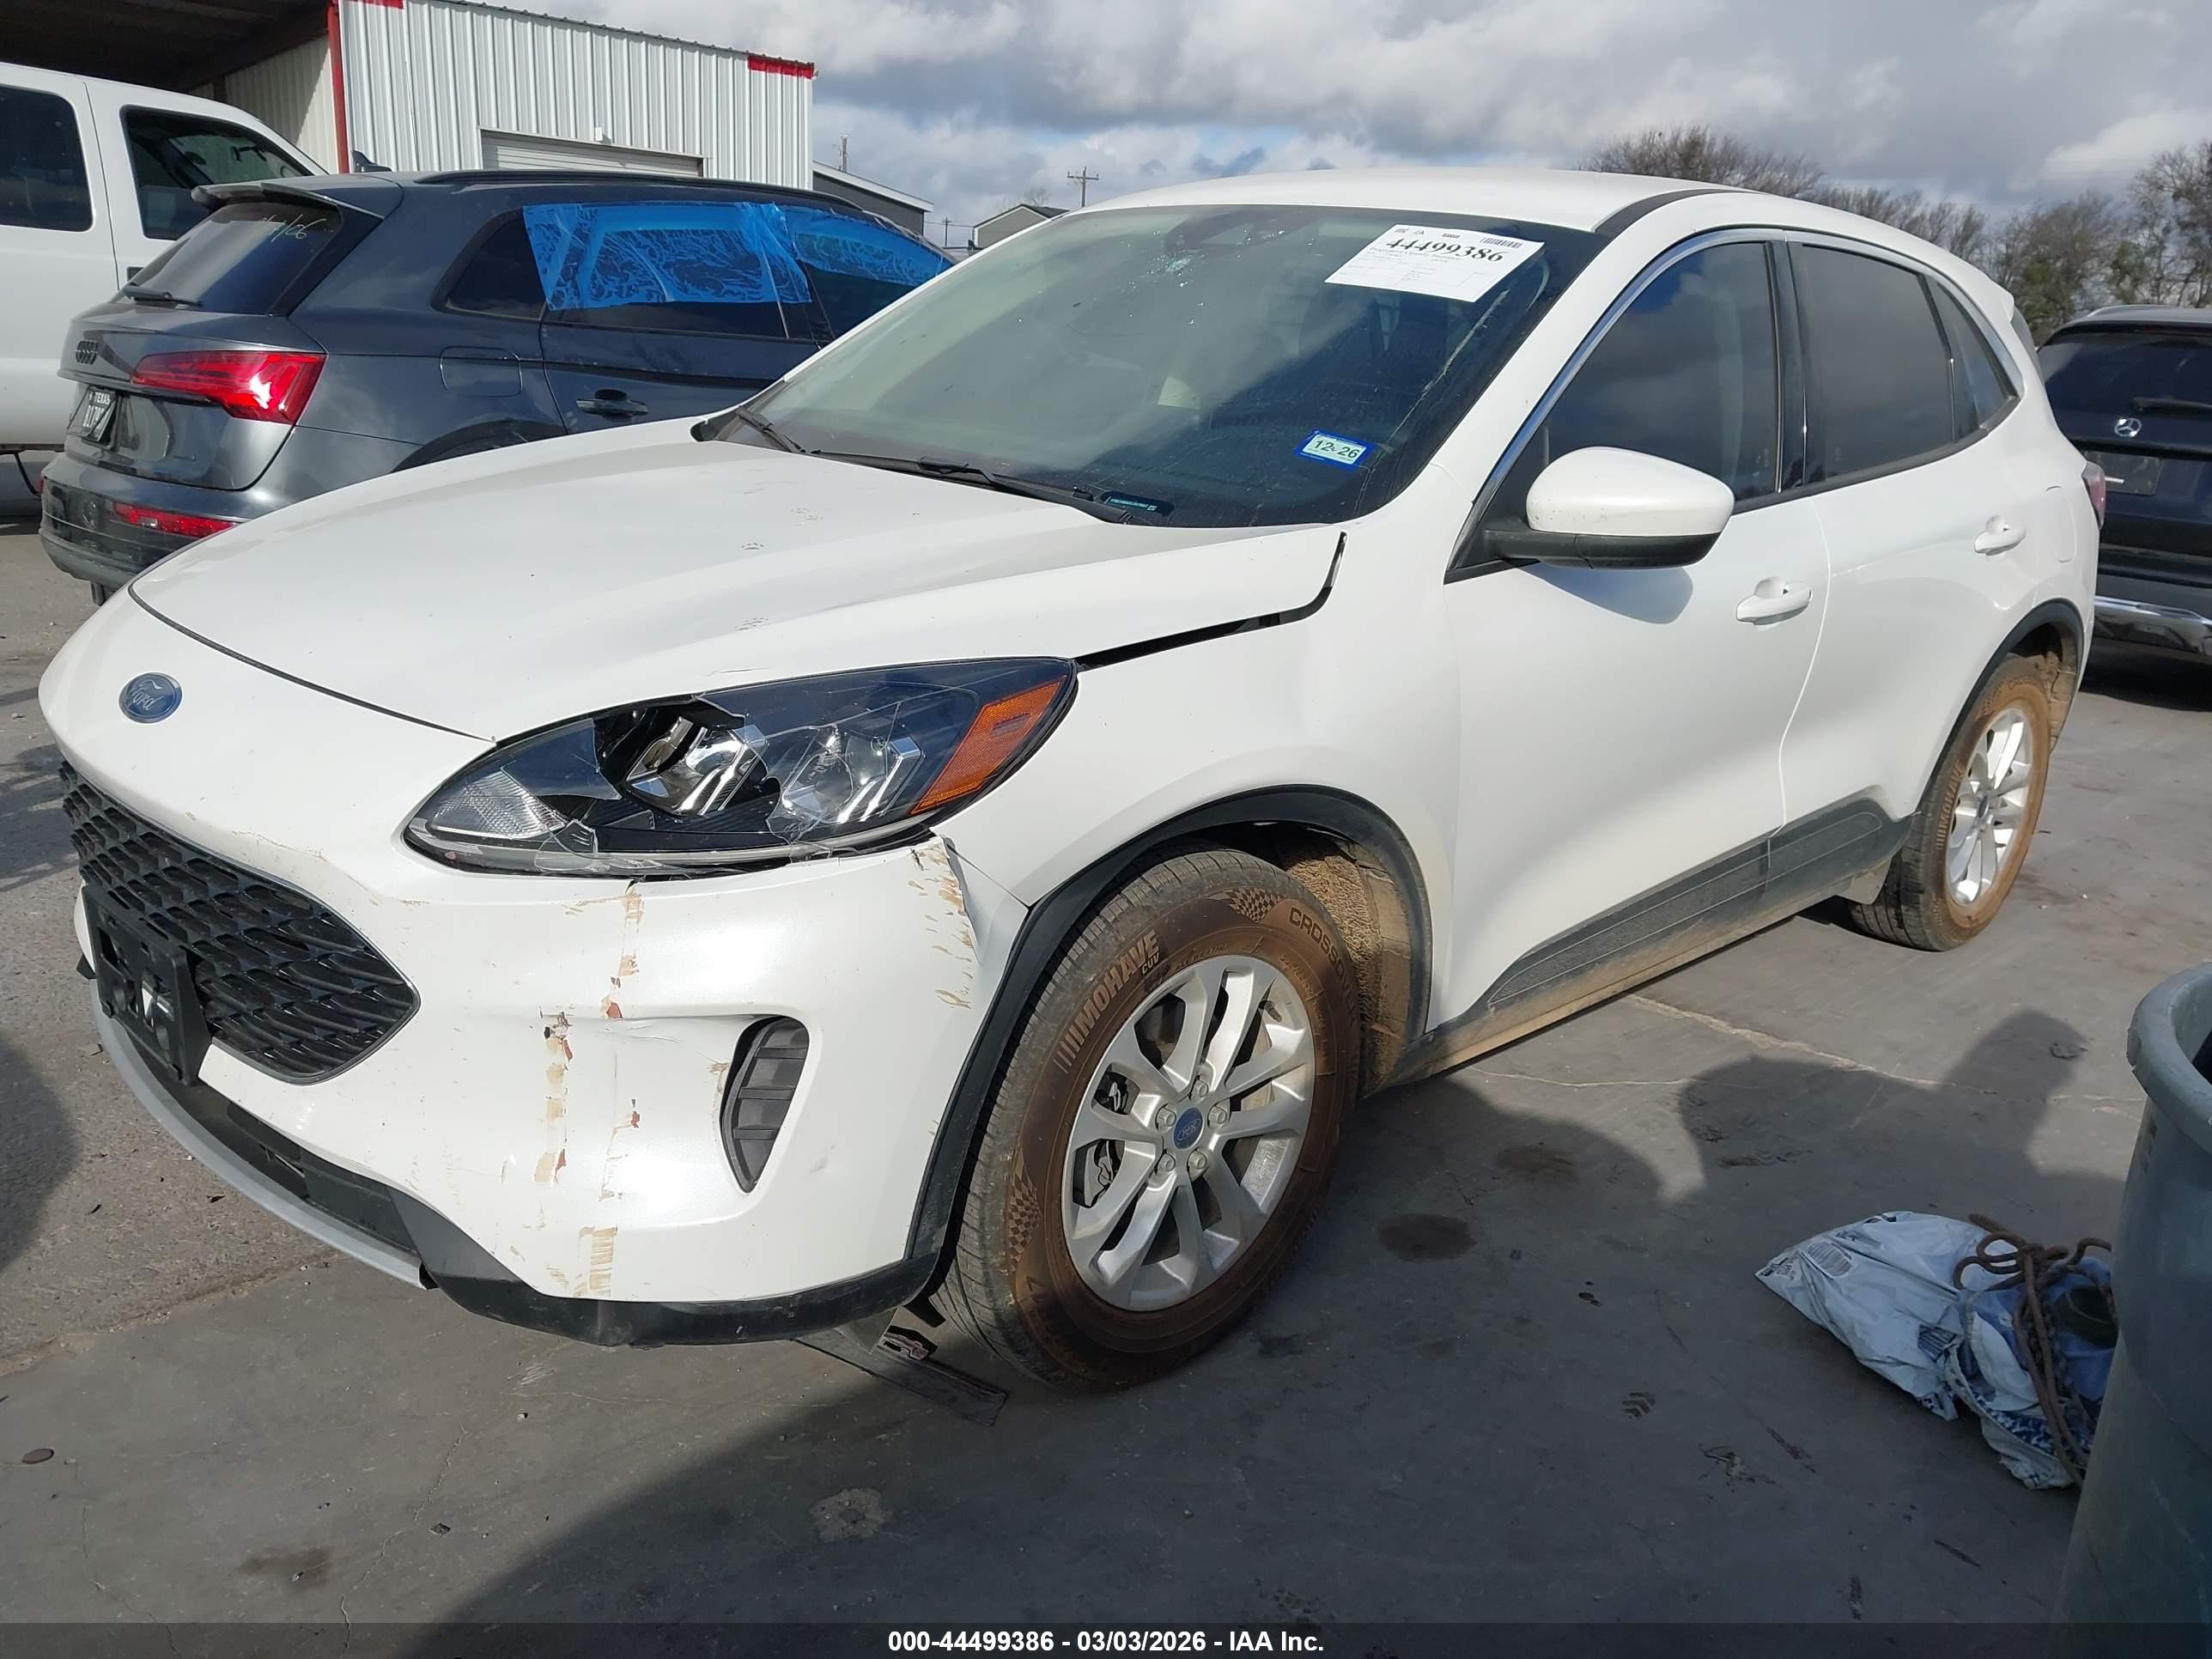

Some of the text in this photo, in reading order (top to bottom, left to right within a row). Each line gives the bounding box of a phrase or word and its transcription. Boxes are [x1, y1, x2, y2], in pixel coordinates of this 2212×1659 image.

[1386, 238, 1510, 262] 44499386
[94, 392, 111, 404] TEXAS
[1315, 441, 1360, 459] 12 26
[1141, 951, 1160, 975] CUV
[1073, 930, 1159, 1038] MOHAVE
